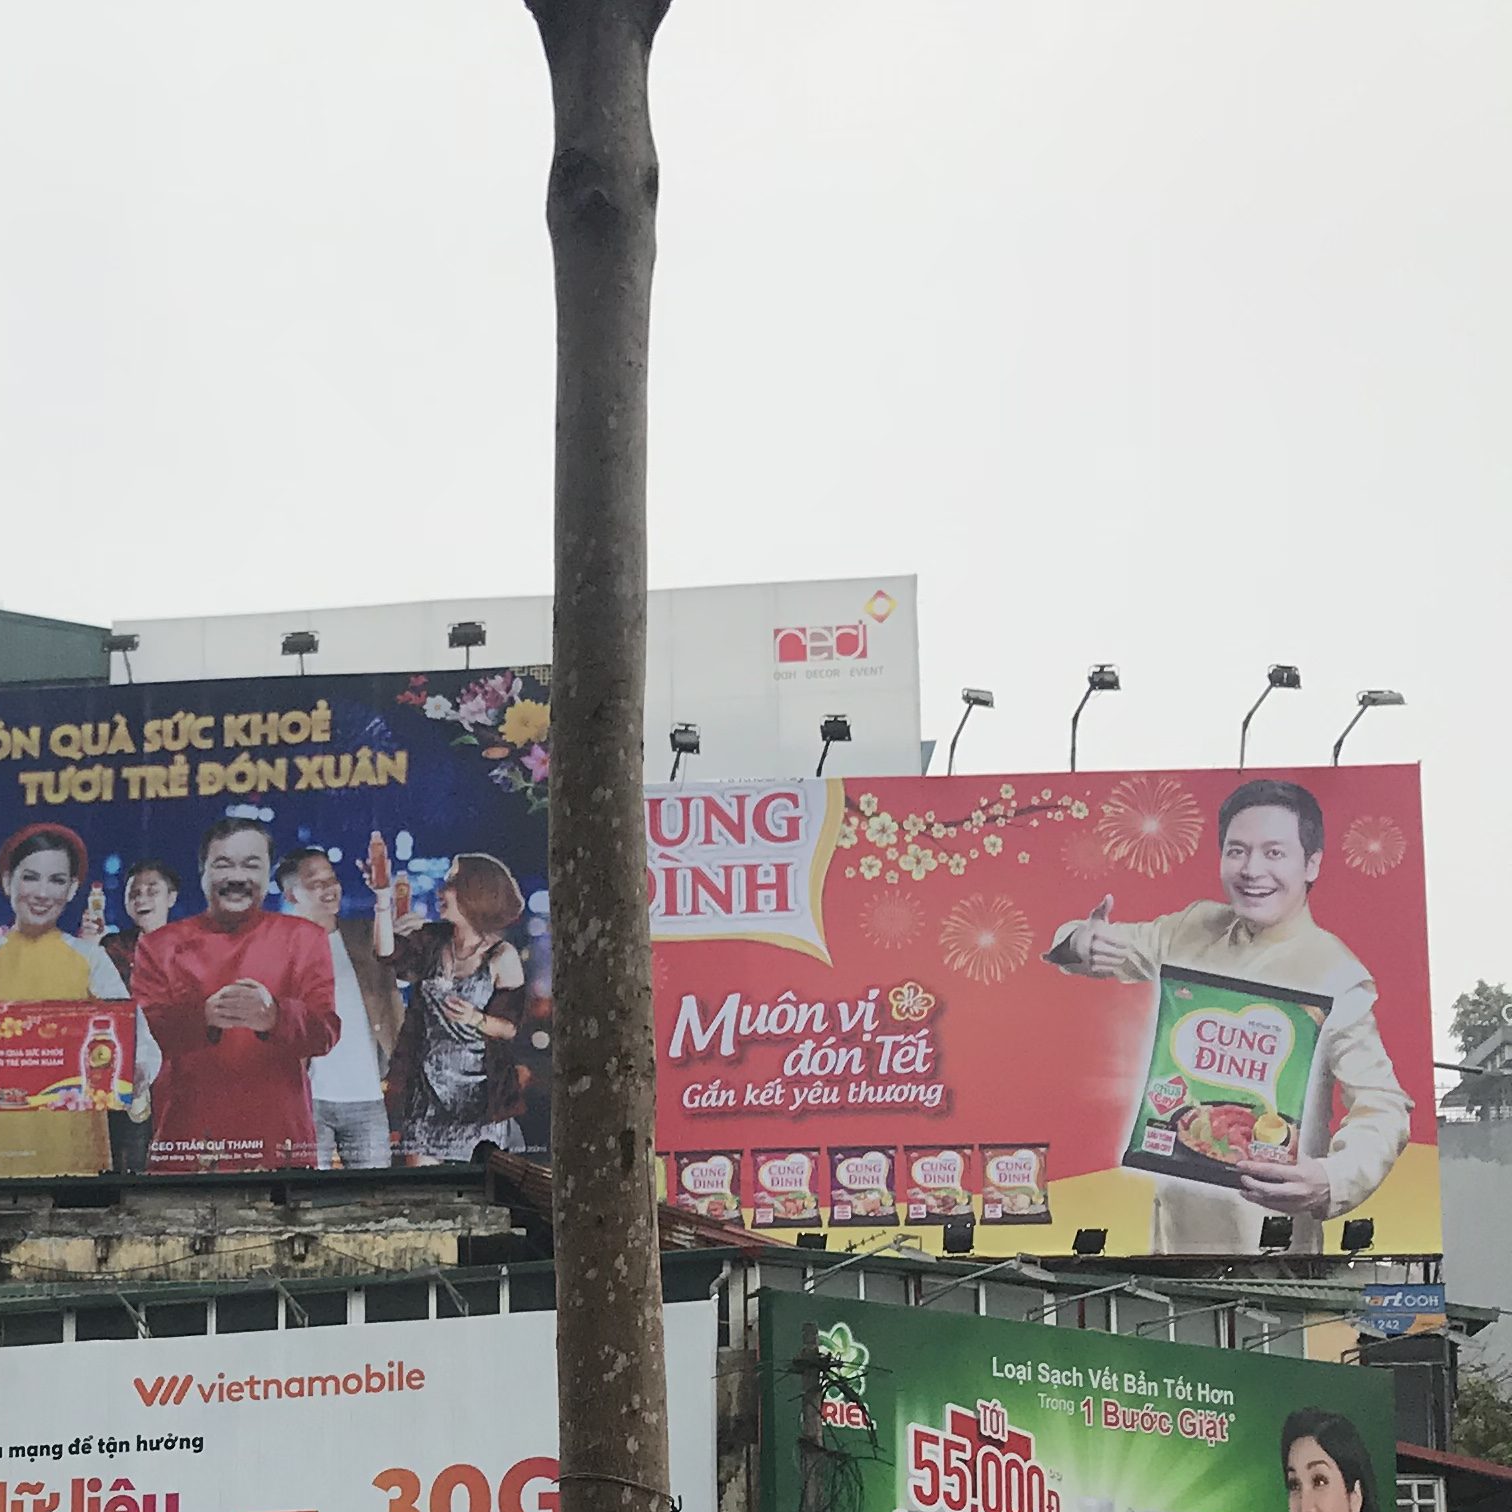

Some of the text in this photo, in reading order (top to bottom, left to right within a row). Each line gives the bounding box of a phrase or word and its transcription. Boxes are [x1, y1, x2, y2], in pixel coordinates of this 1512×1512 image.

[805, 668, 841, 680] DECOR
[849, 666, 885, 678] EVENT
[48, 712, 137, 761] QUÀ
[141, 710, 215, 752] SỨC
[223, 699, 334, 748] KHOẺ
[18, 748, 409, 806] TƯƠI TRẺ ĐÓN XUÂN
[645, 790, 804, 848] UNG
[648, 851, 796, 918] ÌNH
[668, 987, 881, 1058] Muôn vị
[1195, 1019, 1278, 1056] CUNG
[783, 1028, 934, 1077] đón Tết
[683, 1077, 945, 1111] Gắn kết yêu thương
[151, 1141, 174, 1152] CEO
[227, 1139, 264, 1151] THANH
[691, 1167, 727, 1178] CUNG
[768, 1165, 805, 1177] CUNG
[846, 1163, 882, 1176] CUNG
[921, 1162, 957, 1174] CUNG
[996, 1160, 1032, 1173] CUNG
[197, 1360, 427, 1403] vietnamobile
[992, 1356, 1235, 1406] Loại Sạch Vết Bẩn Tốt Hơn
[821, 1400, 875, 1428] RIE
[1038, 1393, 1075, 1415] Trong
[1081, 1396, 1094, 1427] 1
[1101, 1398, 1173, 1435] Bước
[8, 1438, 63, 1465] mạng
[67, 1434, 94, 1456] để
[96, 1435, 131, 1458] tận
[136, 1432, 205, 1457] hưởng
